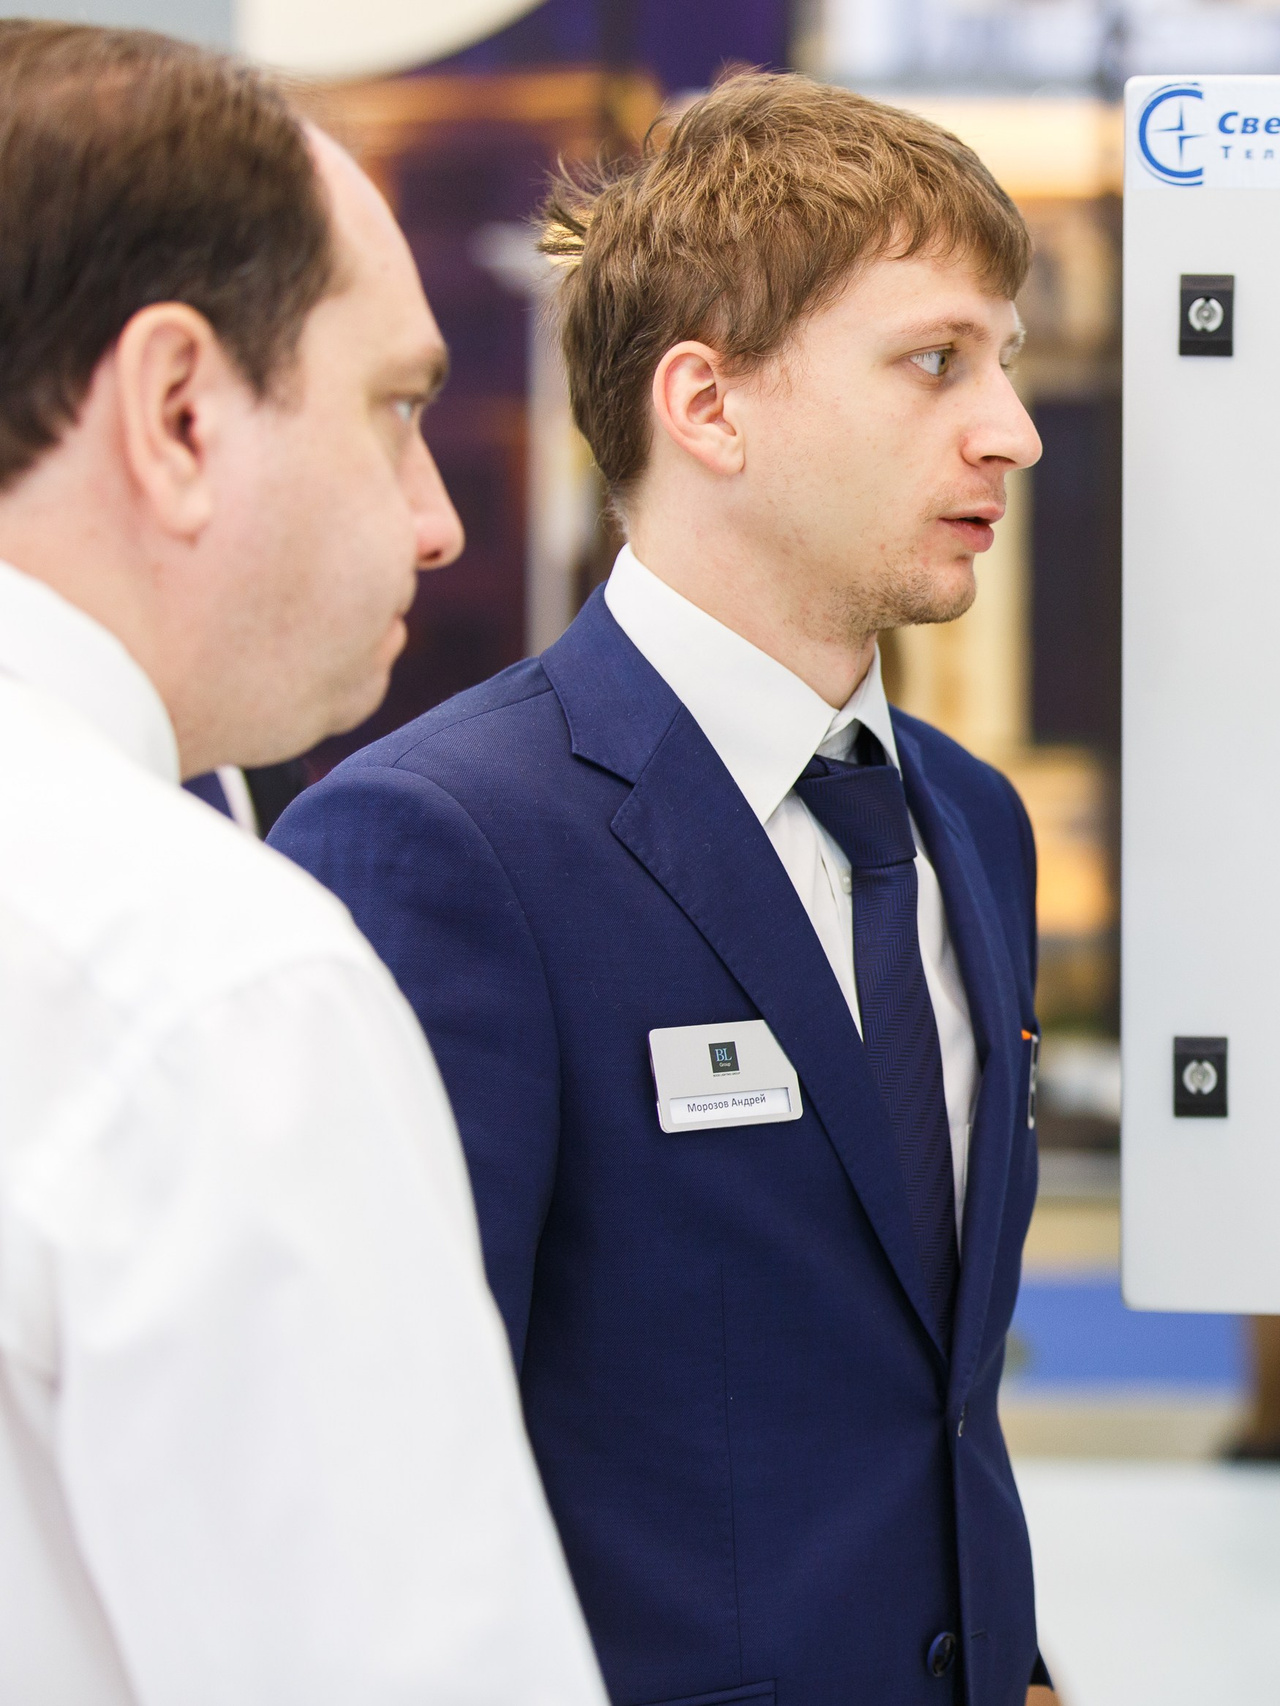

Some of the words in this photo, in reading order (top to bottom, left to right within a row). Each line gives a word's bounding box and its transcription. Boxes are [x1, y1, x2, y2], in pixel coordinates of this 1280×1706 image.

[715, 1048, 732, 1061] BL
[687, 1099, 729, 1113] Морозов
[731, 1093, 766, 1107] Андрей
